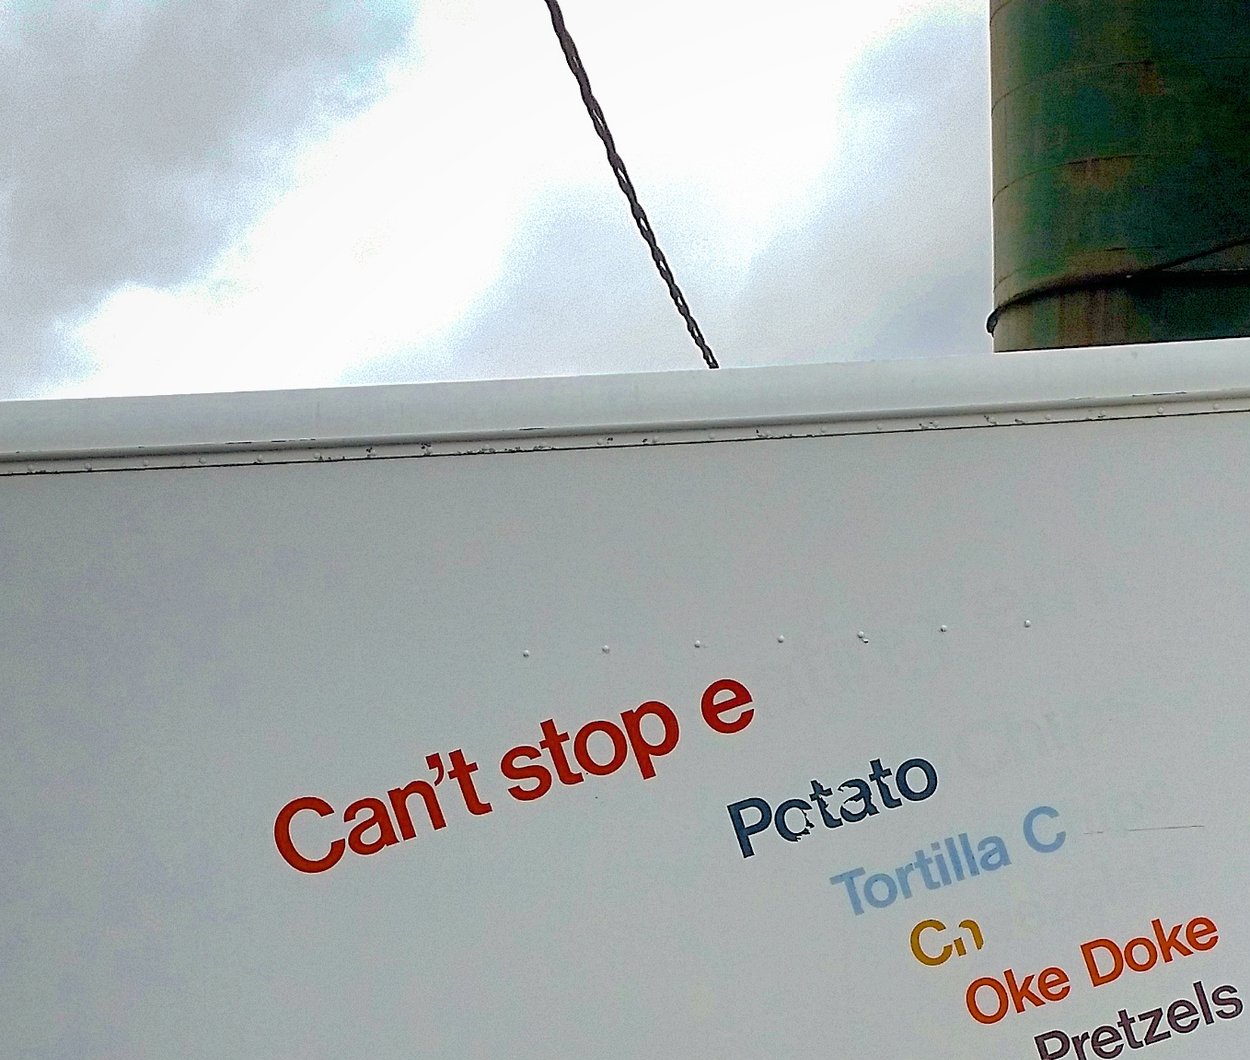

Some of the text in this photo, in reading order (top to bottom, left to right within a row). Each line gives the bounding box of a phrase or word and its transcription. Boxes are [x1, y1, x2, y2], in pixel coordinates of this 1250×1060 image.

[274, 679, 754, 874] Can't stop e
[727, 758, 938, 858] Potato
[829, 805, 1066, 915] Tortilla C
[966, 917, 1218, 1024] Oke Doke
